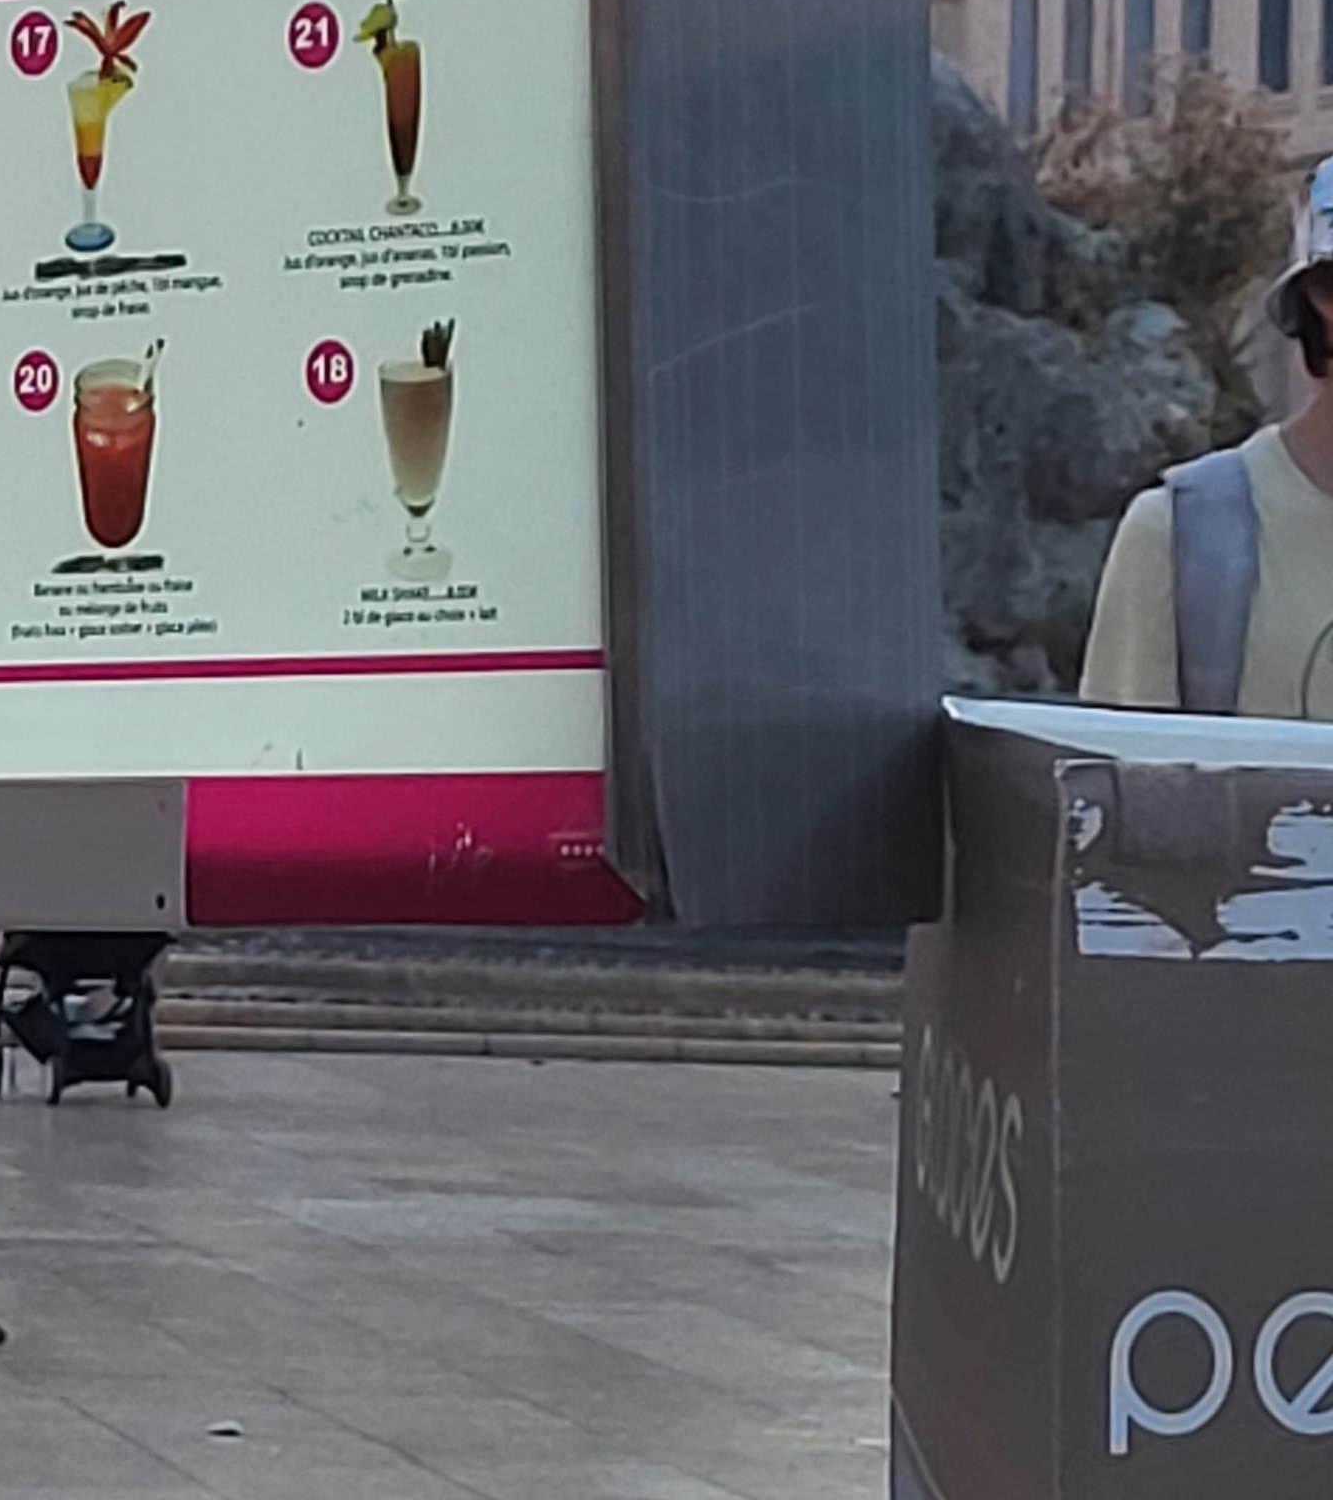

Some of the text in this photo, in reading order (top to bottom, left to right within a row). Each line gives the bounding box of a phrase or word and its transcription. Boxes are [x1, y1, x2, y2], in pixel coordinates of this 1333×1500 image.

[17, 25, 50, 55] 17
[295, 17, 328, 47] 21
[20, 365, 51, 394] 20
[313, 353, 347, 383] 18
